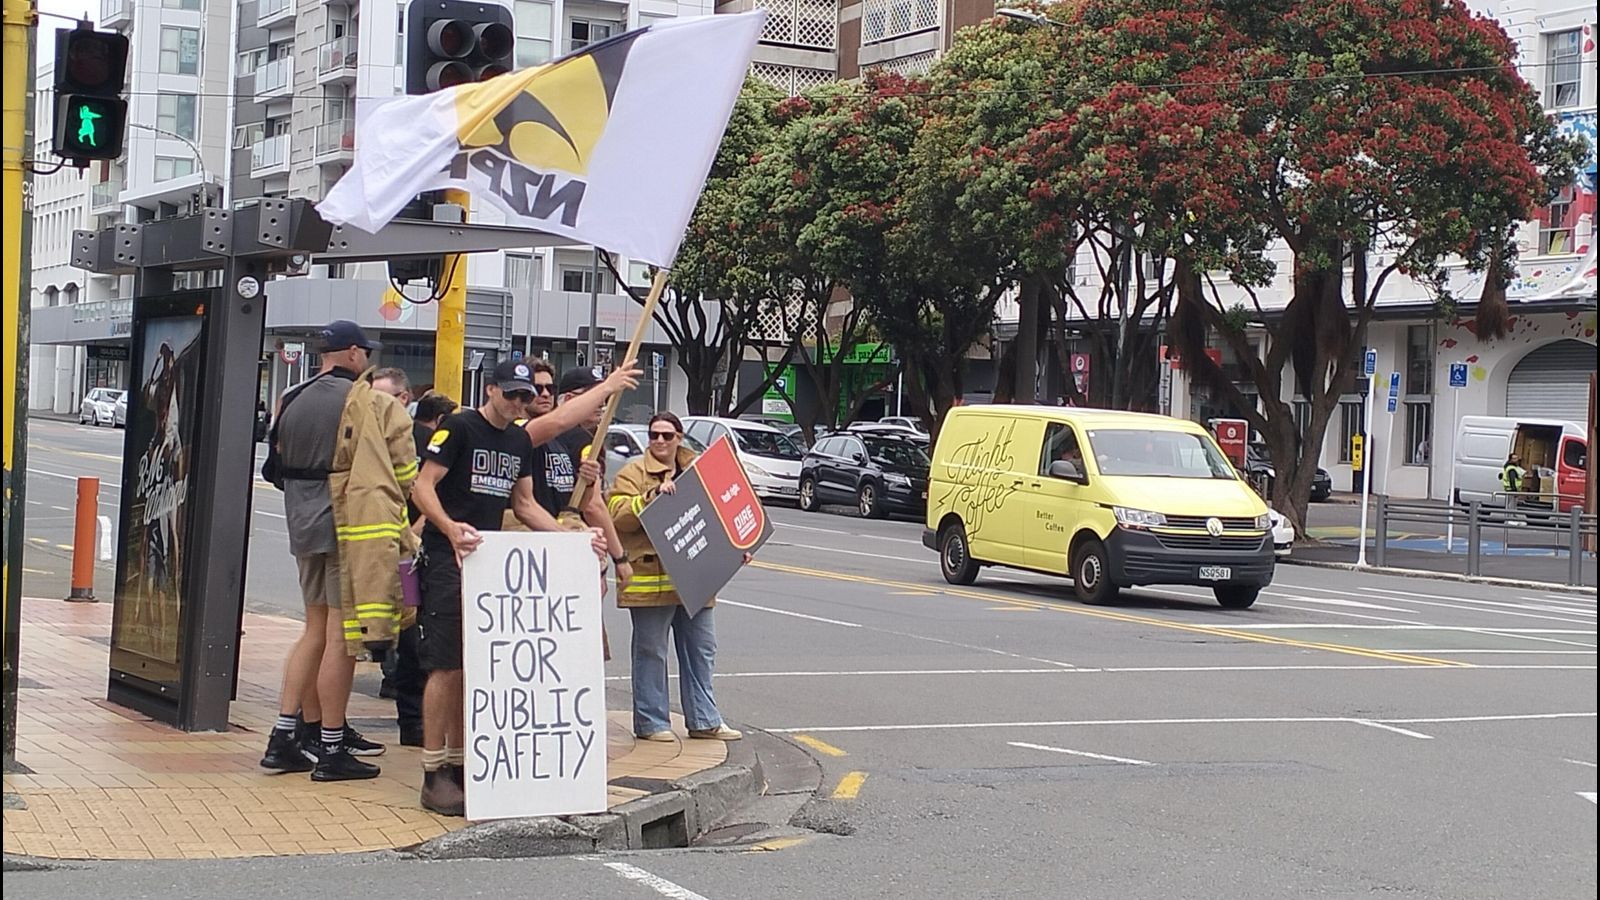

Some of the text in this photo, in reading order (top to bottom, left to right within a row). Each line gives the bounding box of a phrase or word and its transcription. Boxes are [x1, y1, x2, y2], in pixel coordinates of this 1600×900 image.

[472, 449, 521, 480] DIRE
[947, 419, 1014, 484] Flight
[733, 504, 754, 531] DIRE
[505, 547, 548, 594] ON
[476, 592, 582, 634] STRIKE
[490, 637, 561, 683] FOR
[472, 687, 592, 732] PUBLIC
[472, 730, 595, 783] SAFETY
